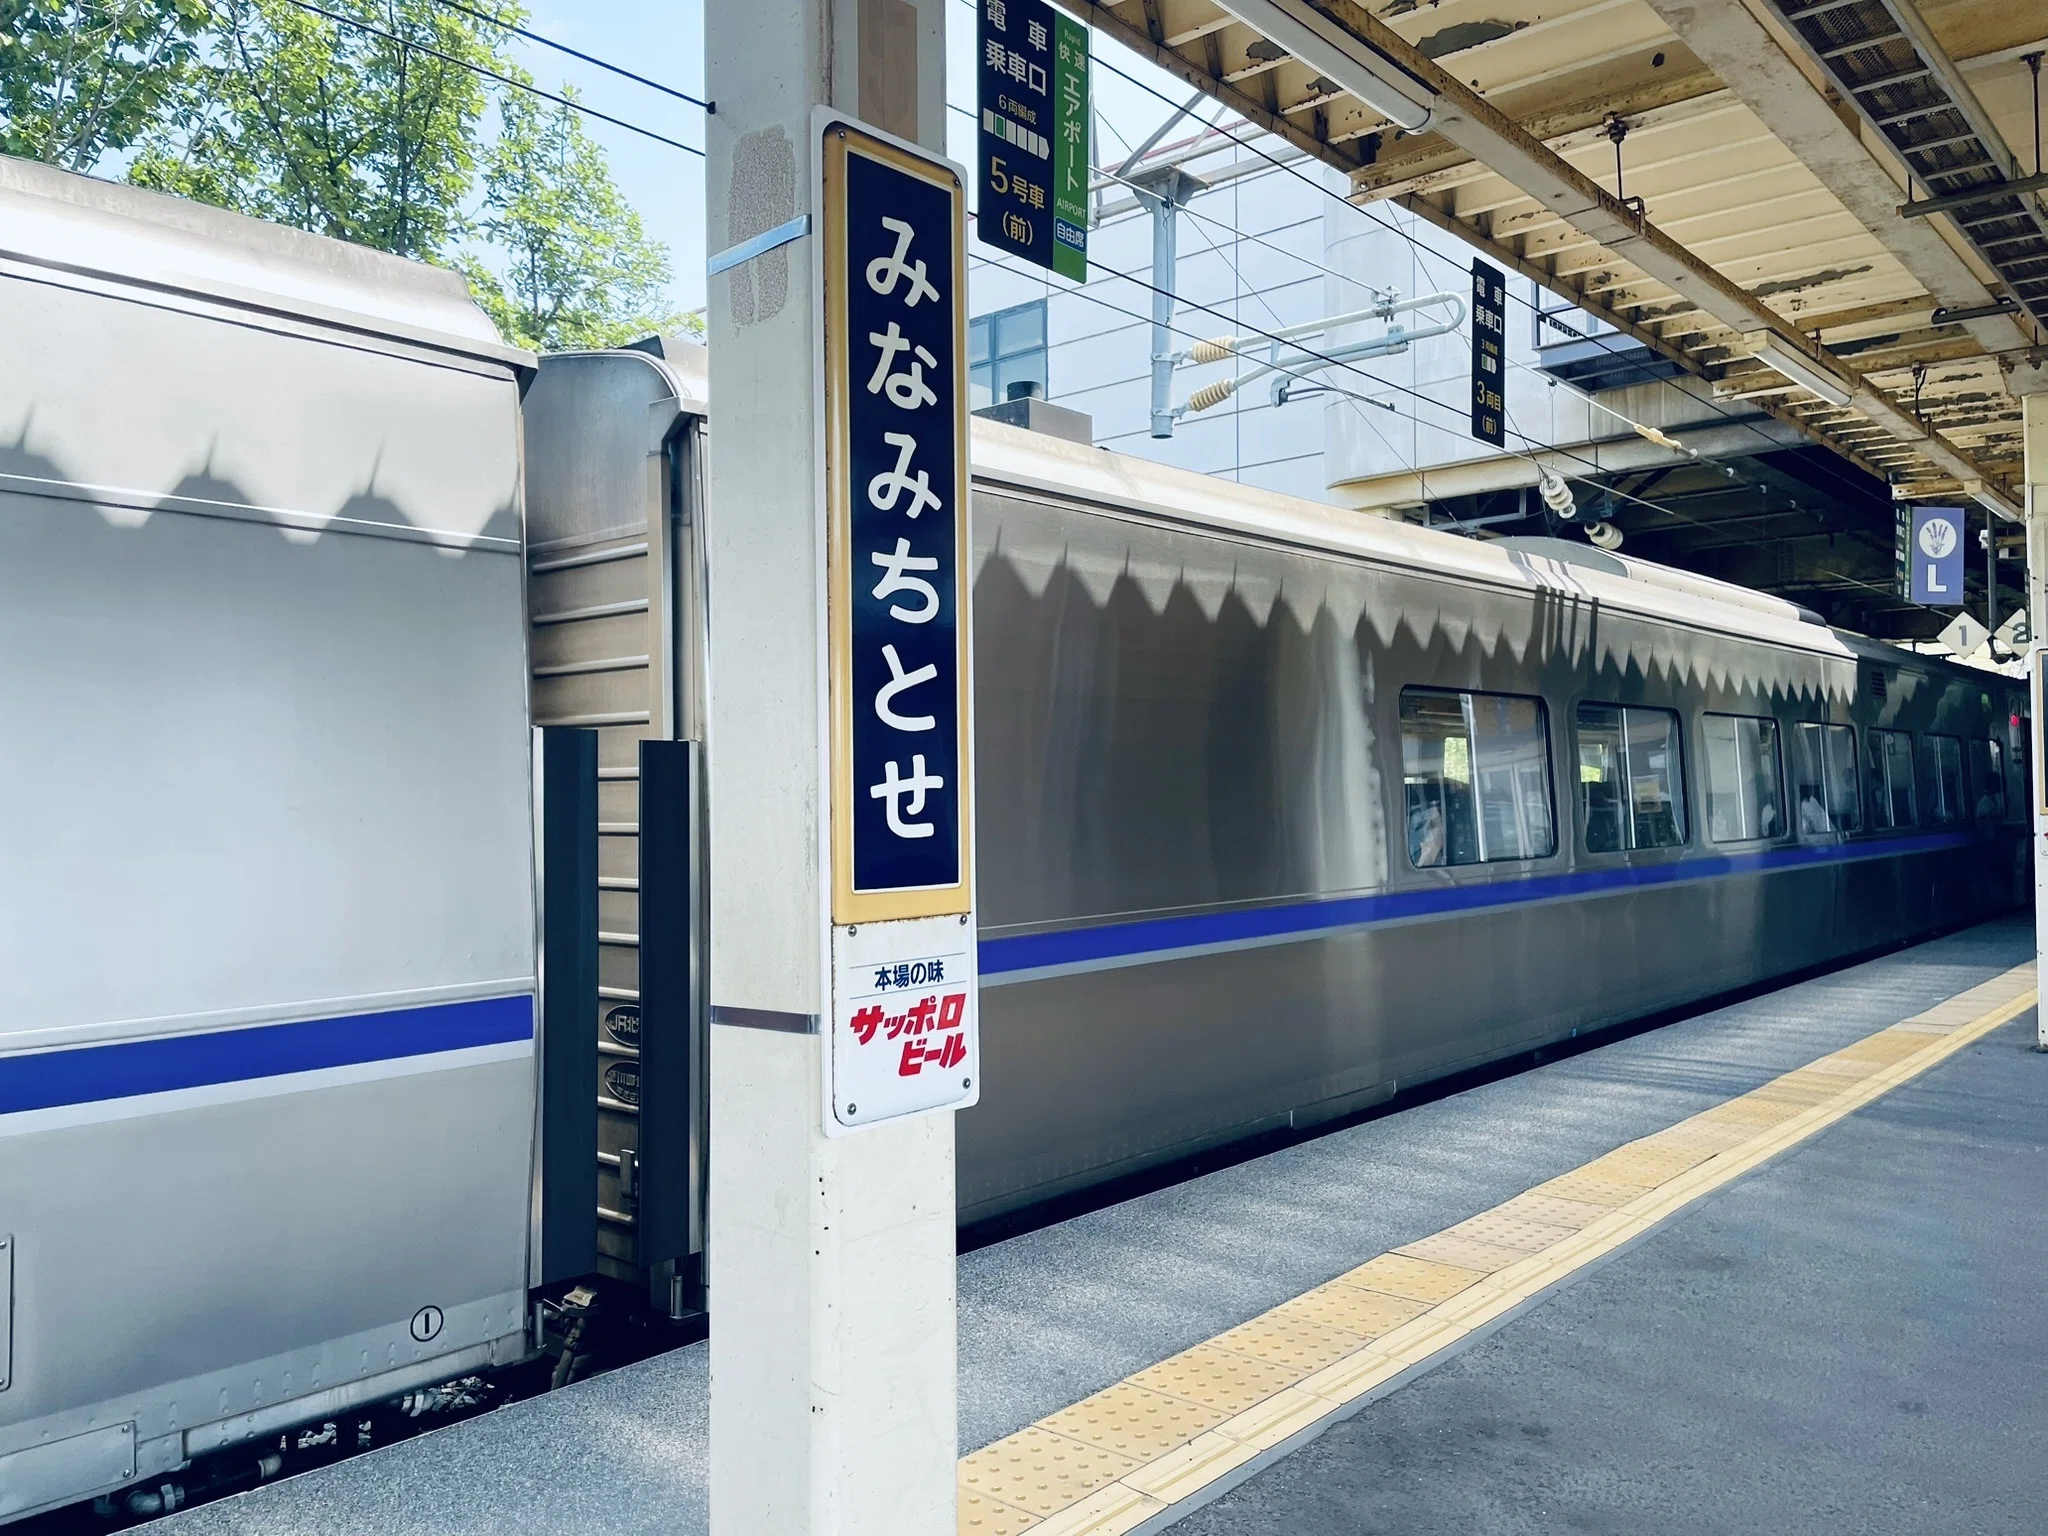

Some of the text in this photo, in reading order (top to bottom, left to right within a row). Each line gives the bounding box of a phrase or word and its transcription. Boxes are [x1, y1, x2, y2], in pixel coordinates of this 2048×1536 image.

[986, 39, 1047, 96] 乗車口
[1059, 41, 1086, 72] 快速
[998, 94, 1037, 125] 6両編成
[1063, 72, 1081, 192] エアポート
[991, 155, 1045, 210] 5号車
[1056, 197, 1087, 220] AIRPORT
[1056, 222, 1085, 248] 自由席
[1475, 304, 1503, 336] 乗車口
[866, 216, 944, 839] みなみちとせ
[1927, 564, 1947, 592] L
[1958, 625, 1968, 646] 1
[2012, 622, 2030, 644] 2
[874, 959, 944, 991] 本場の味
[850, 993, 966, 1046] サッポロ
[898, 1032, 967, 1077] ビール
